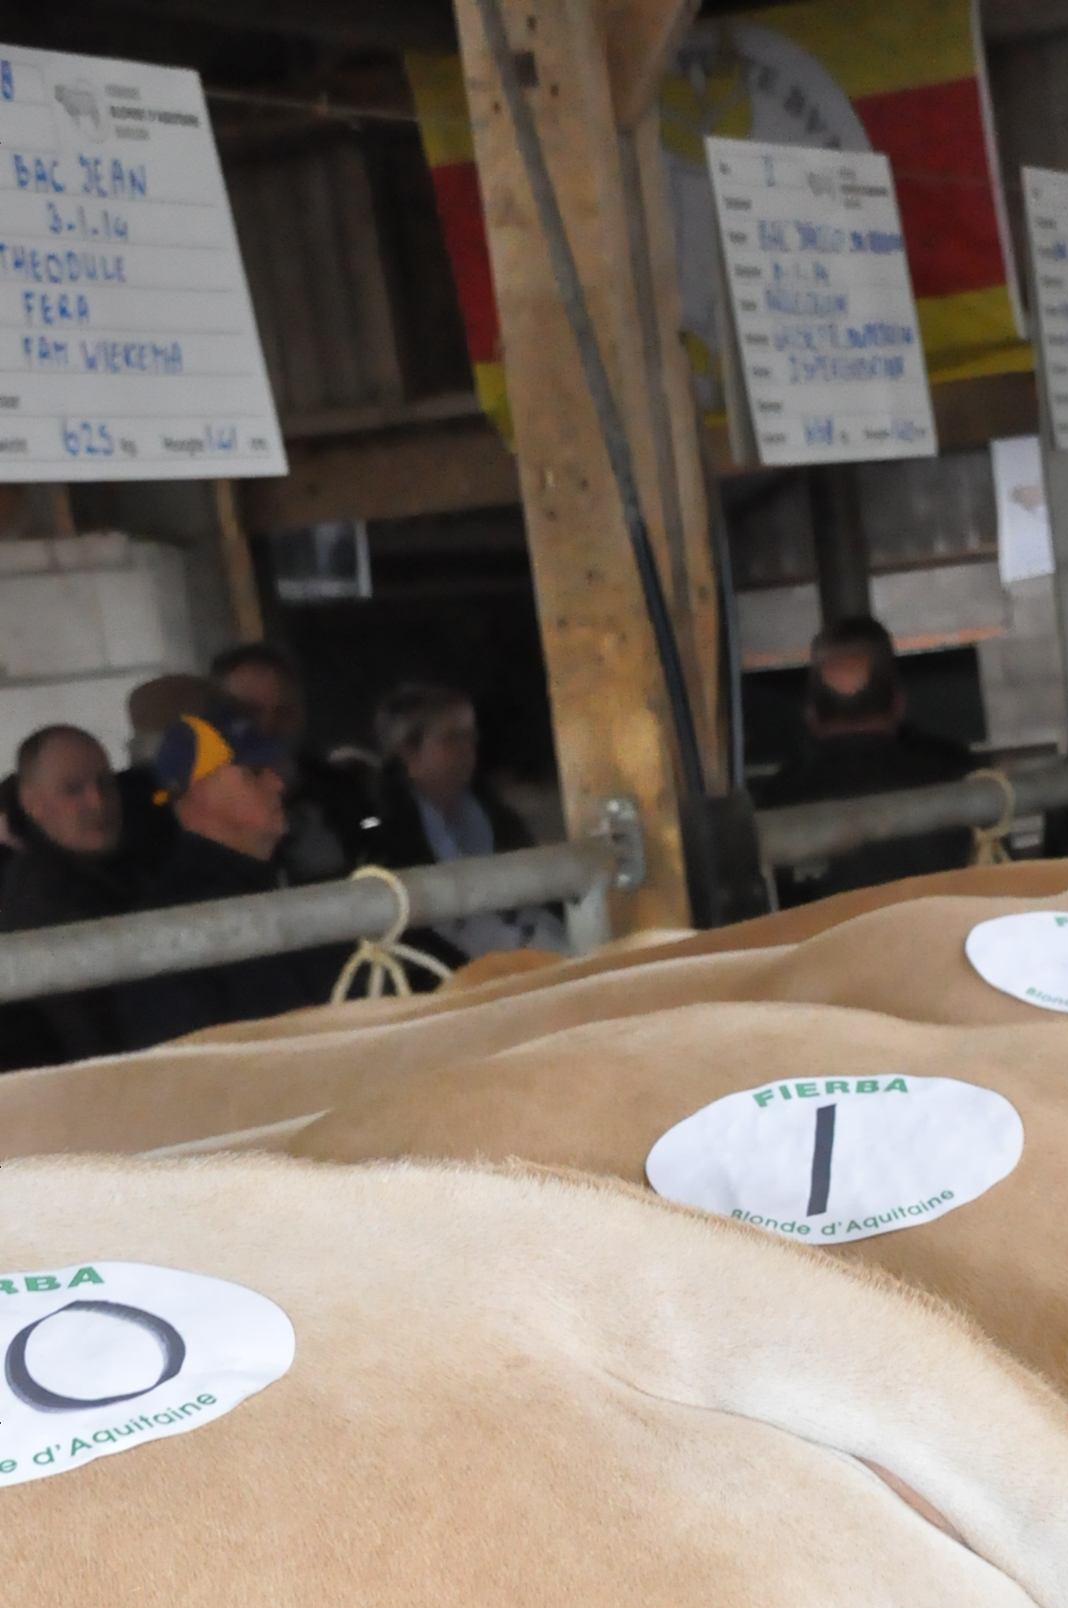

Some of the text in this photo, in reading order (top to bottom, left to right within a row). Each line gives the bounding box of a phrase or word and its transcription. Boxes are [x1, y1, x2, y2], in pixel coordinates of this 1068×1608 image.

[78, 154, 147, 199] JEAN
[61, 416, 114, 456] 625
[752, 1077, 909, 1108] FIERBA
[806, 1103, 838, 1217] 1
[731, 1188, 956, 1237] Blonde d'Aquitaine
[32, 1393, 218, 1466] d'Aquitaine
